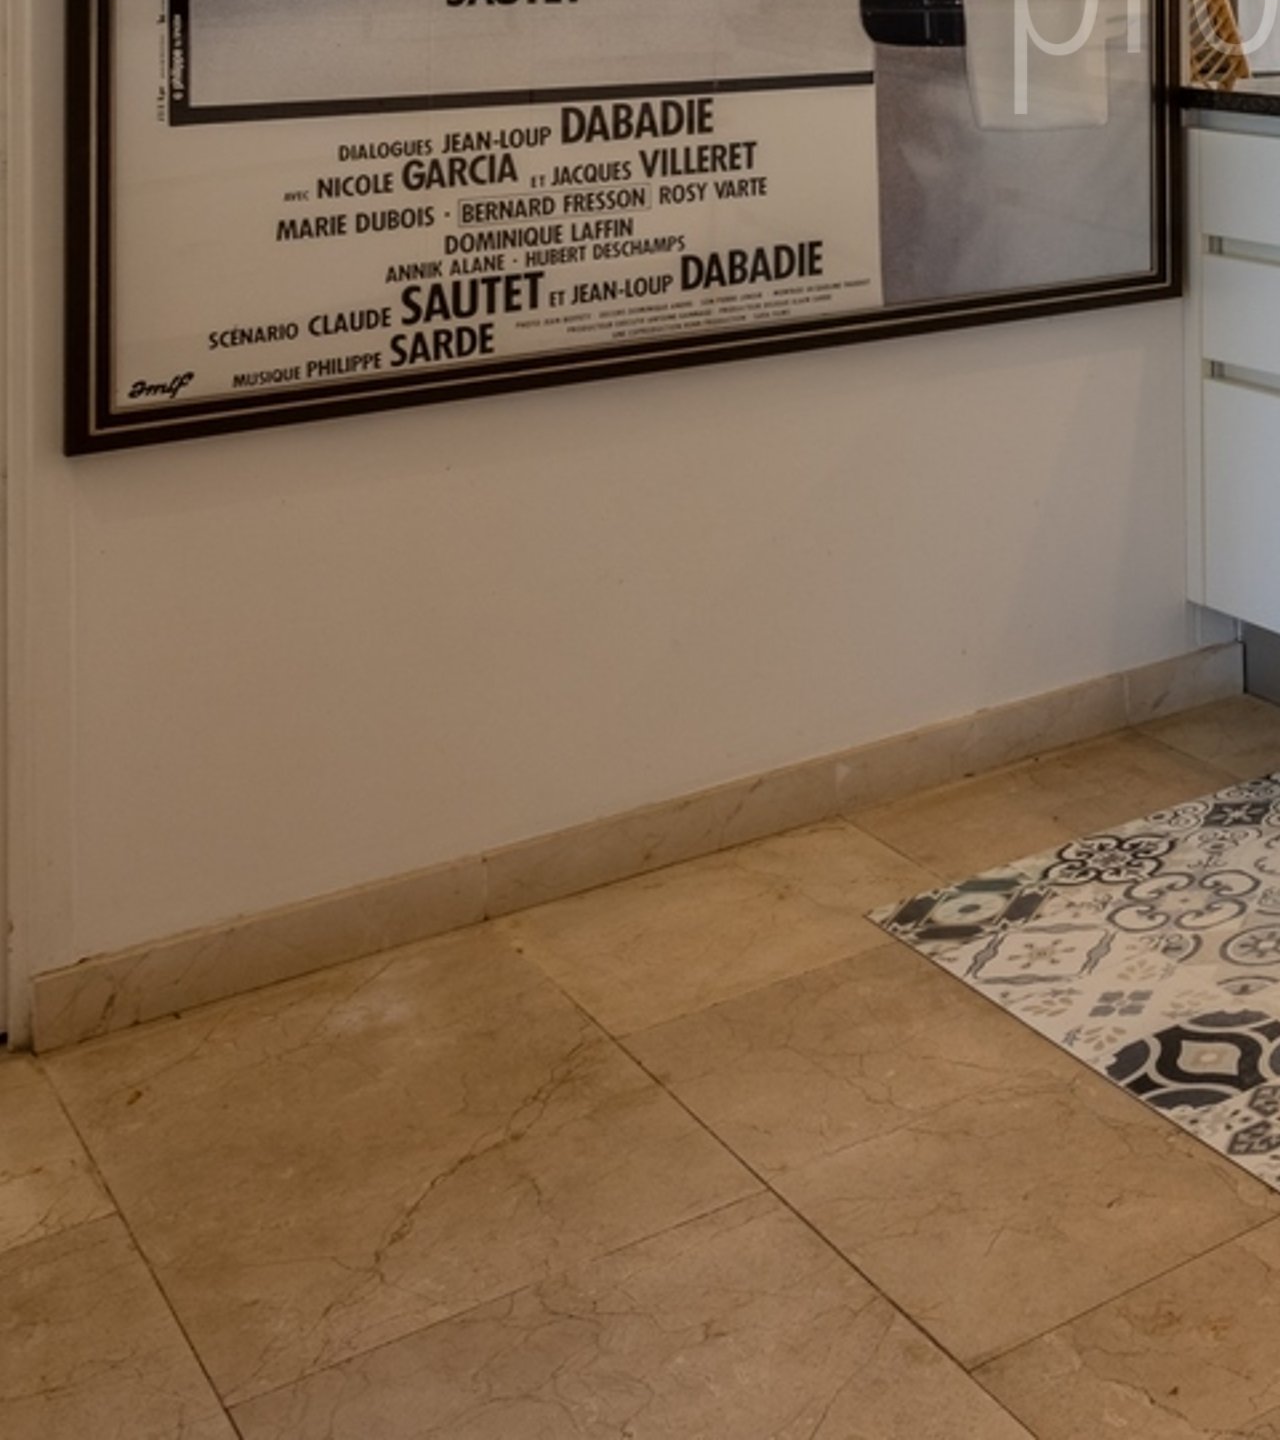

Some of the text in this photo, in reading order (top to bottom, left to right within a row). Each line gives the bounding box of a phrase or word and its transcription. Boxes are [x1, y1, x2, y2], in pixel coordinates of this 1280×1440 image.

[339, 98, 713, 162] DIALOGUES JEAN-LOUP DABADIE
[317, 173, 394, 200] NICOLE
[402, 154, 517, 191] GARCIA
[530, 174, 545, 188] ET
[551, 160, 631, 186] JACQUES
[639, 141, 757, 178] VILLERET
[276, 177, 768, 242] MARIE DUBOIS BERNARD FRESSON ROSY VARTE
[444, 218, 634, 255] DOMINIQUE LAFFIN
[308, 307, 392, 336] CLAUDE
[400, 271, 544, 325] SAUTET
[549, 290, 566, 307] ET
[570, 276, 674, 304] JEAN-LOUP
[680, 240, 823, 291] DABADIE
[386, 235, 686, 283] ANNIK ALANE HUBERT DESCHAMPS
[233, 323, 495, 388] MUSIQUE PHILIPPE SARDE
